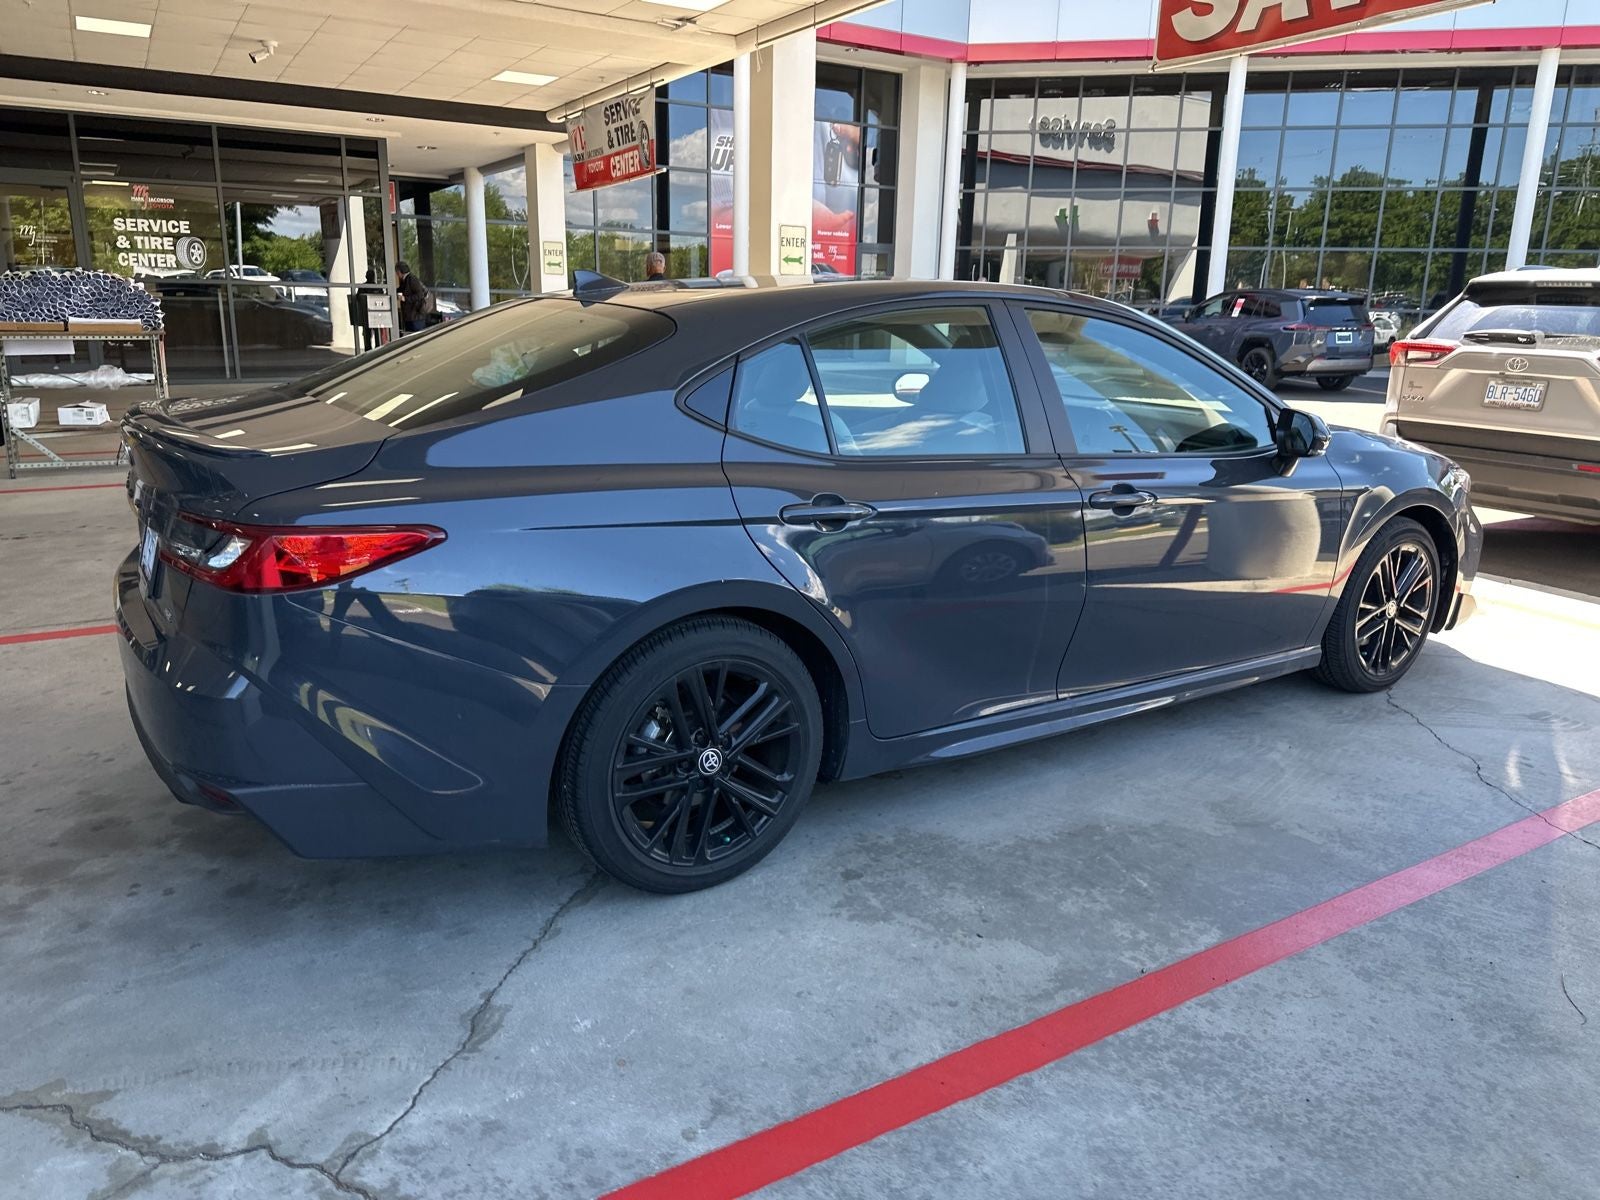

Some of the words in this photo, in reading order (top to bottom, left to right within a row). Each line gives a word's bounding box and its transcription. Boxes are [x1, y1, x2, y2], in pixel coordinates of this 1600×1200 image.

[607, 130, 615, 149] &
[614, 122, 637, 146] TIRE
[610, 149, 640, 178] CENTER
[113, 217, 191, 234] SERVICE
[116, 235, 131, 249] &
[134, 235, 175, 250] TIRE
[781, 237, 806, 248] ENTER
[118, 252, 177, 268] CENTER
